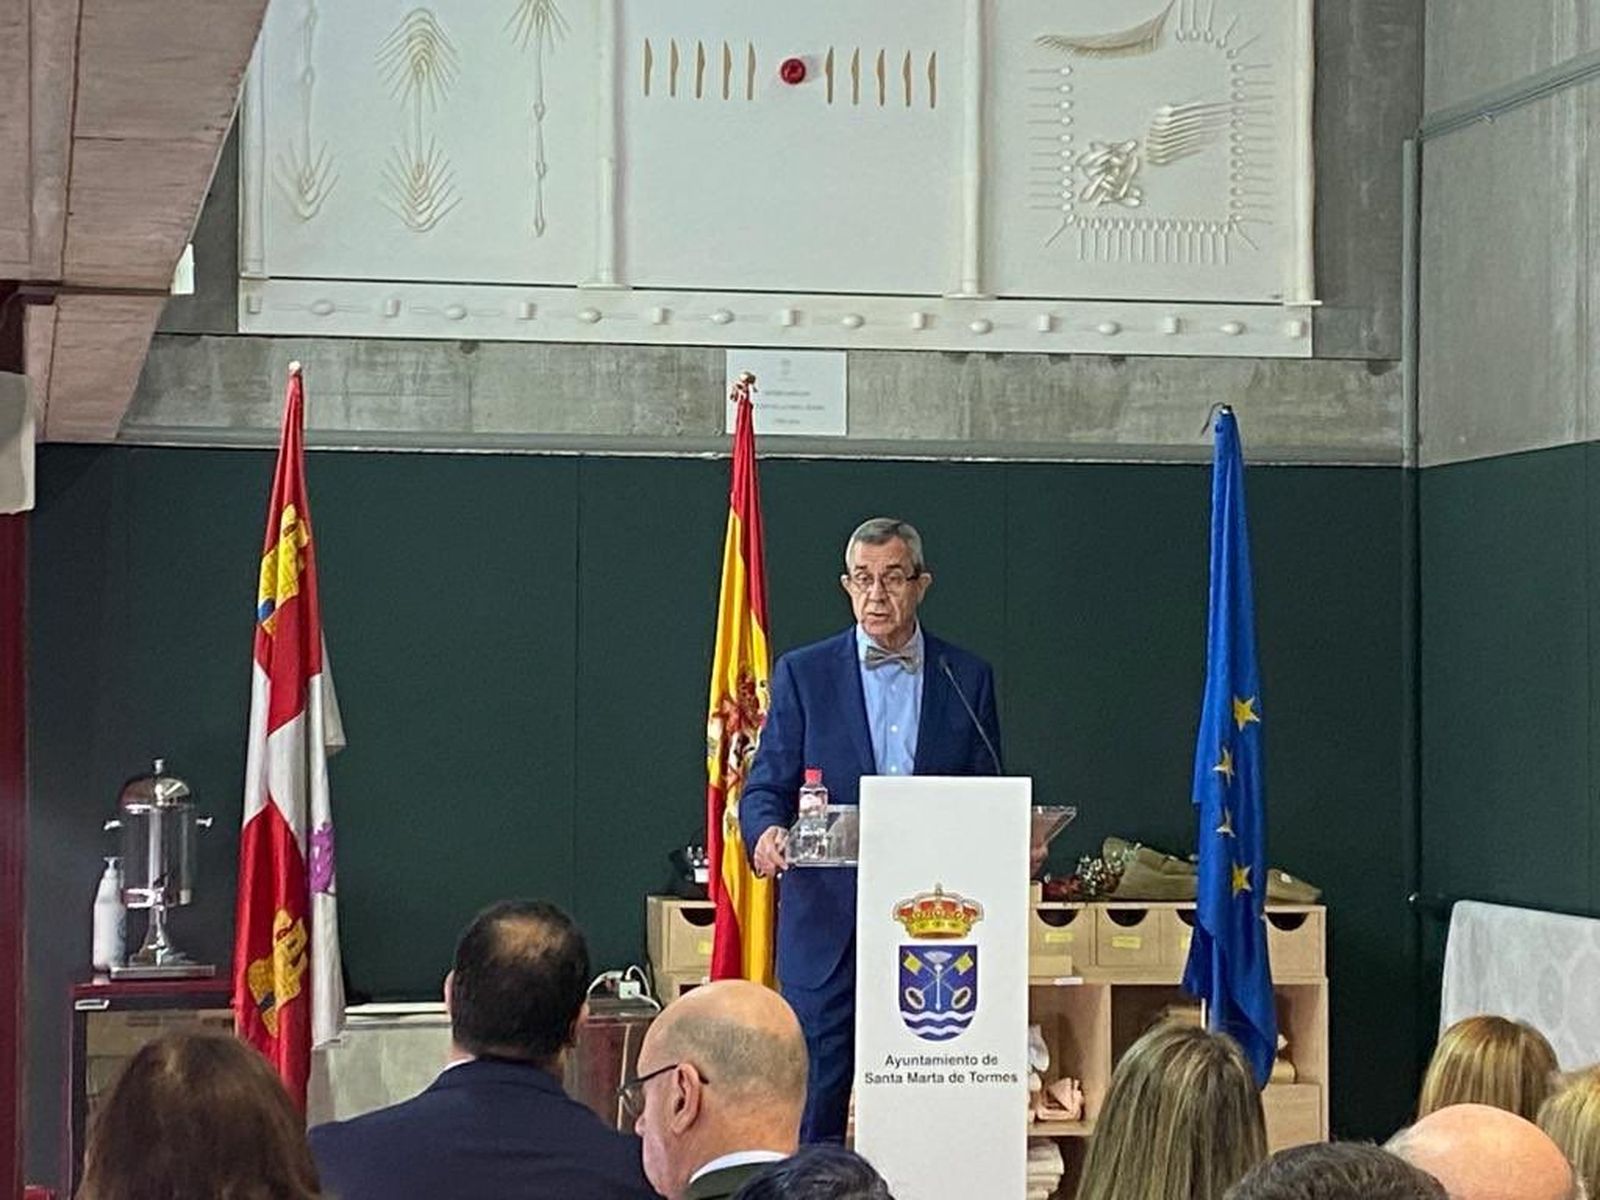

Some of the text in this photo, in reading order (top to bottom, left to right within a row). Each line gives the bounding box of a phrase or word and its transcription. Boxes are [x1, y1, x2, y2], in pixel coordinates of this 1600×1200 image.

[885, 1054, 998, 1069] Ayuntamiento de
[865, 1071, 1018, 1084] Santa Marta de Tormes
